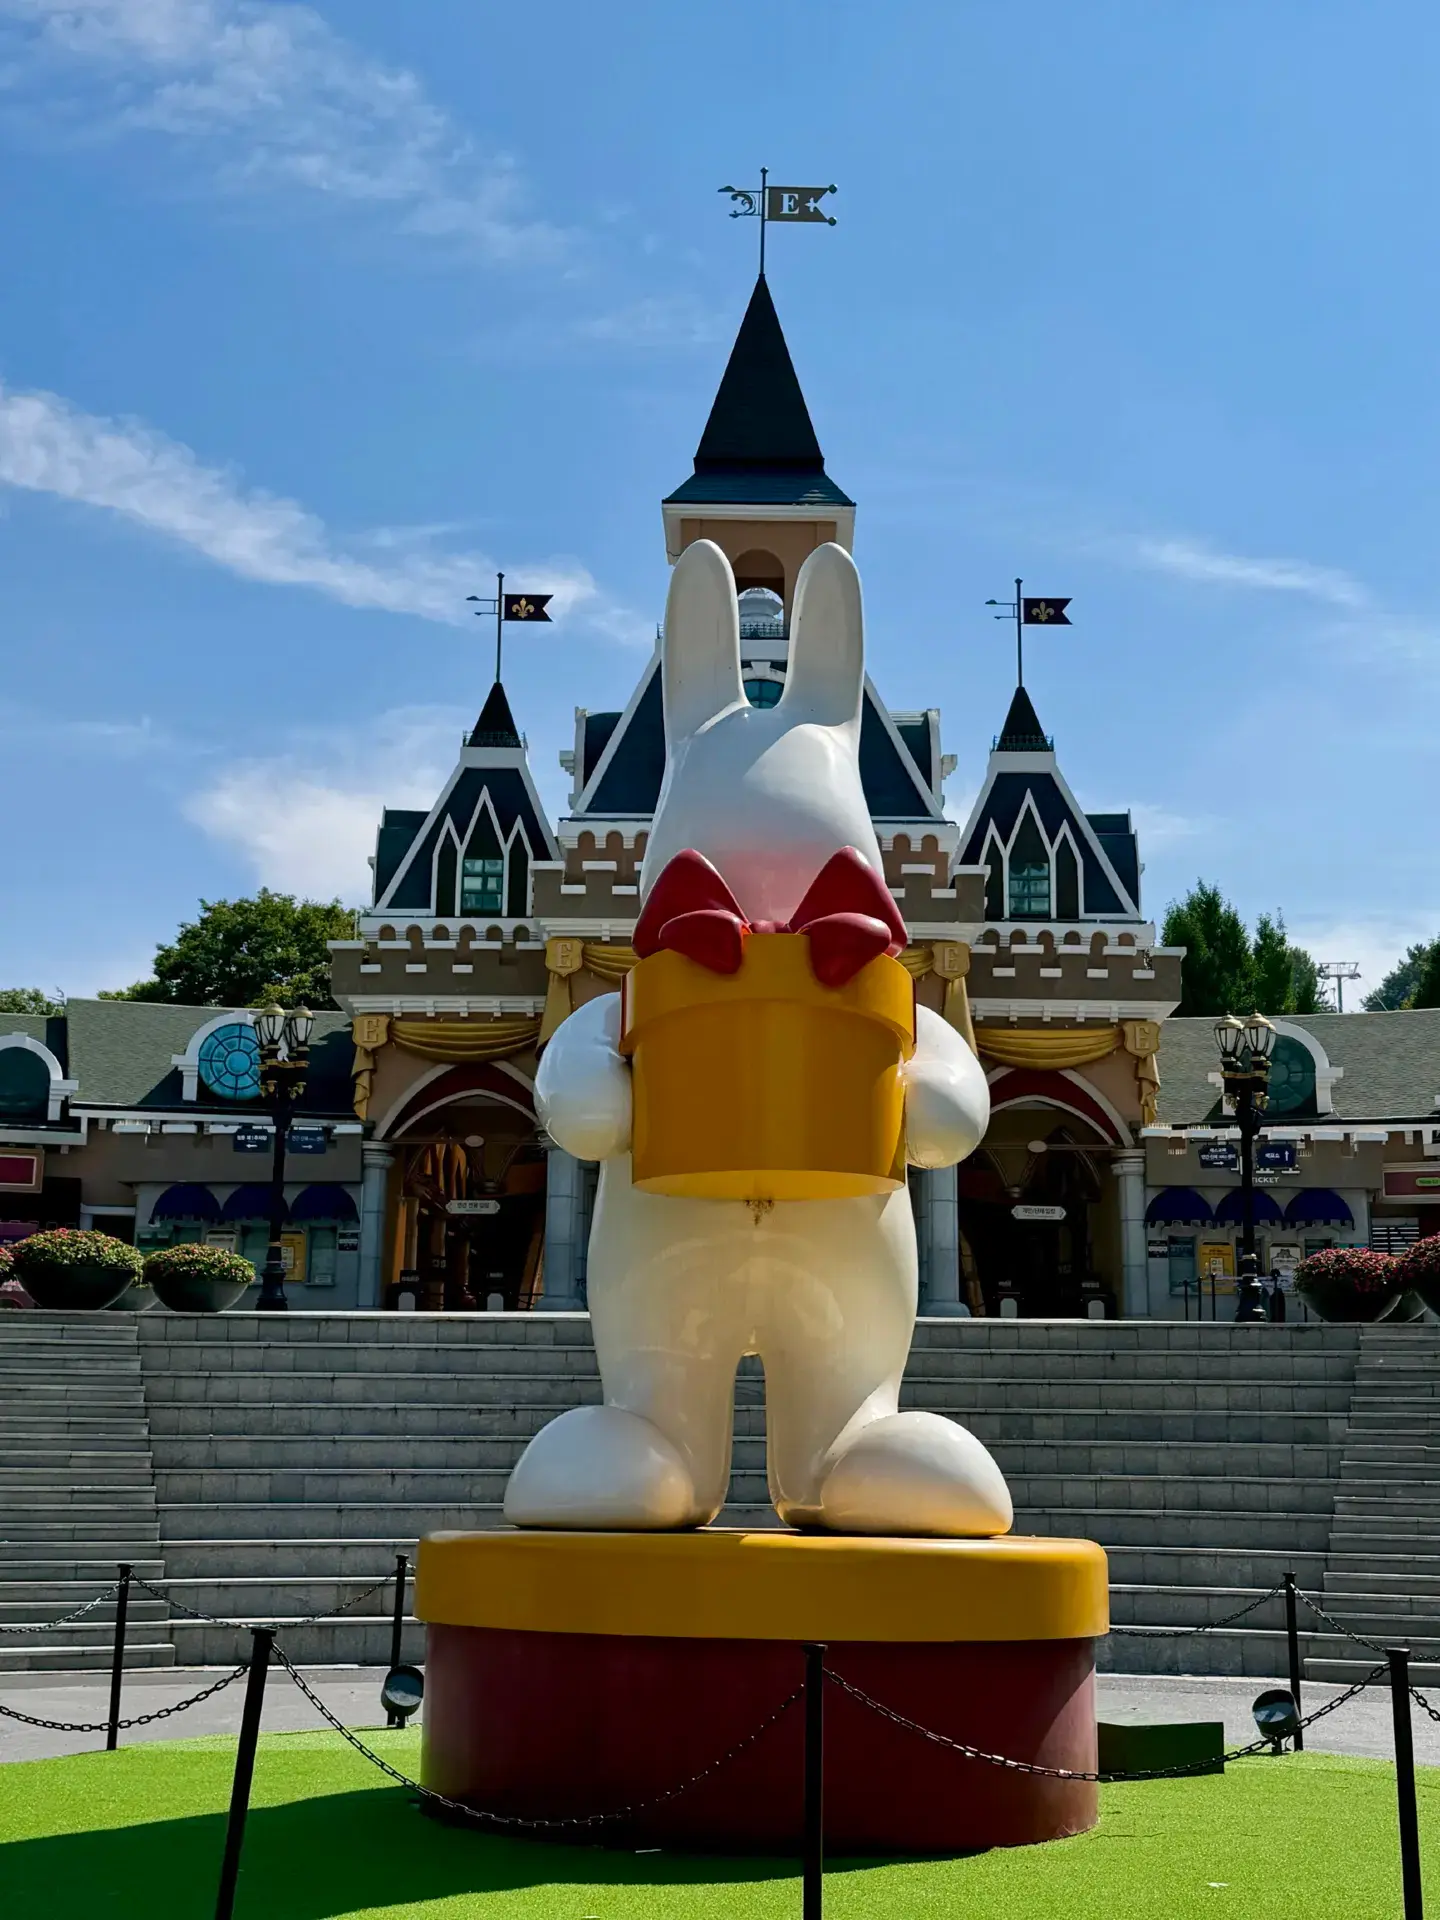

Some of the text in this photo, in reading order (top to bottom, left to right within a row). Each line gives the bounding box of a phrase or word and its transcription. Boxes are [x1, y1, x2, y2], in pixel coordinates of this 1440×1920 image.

[780, 193, 799, 214] E
[556, 942, 573, 968] E
[944, 947, 959, 972] E
[363, 1018, 380, 1042] E
[1134, 1025, 1150, 1049] E
[1252, 1176, 1280, 1184] TICKET
